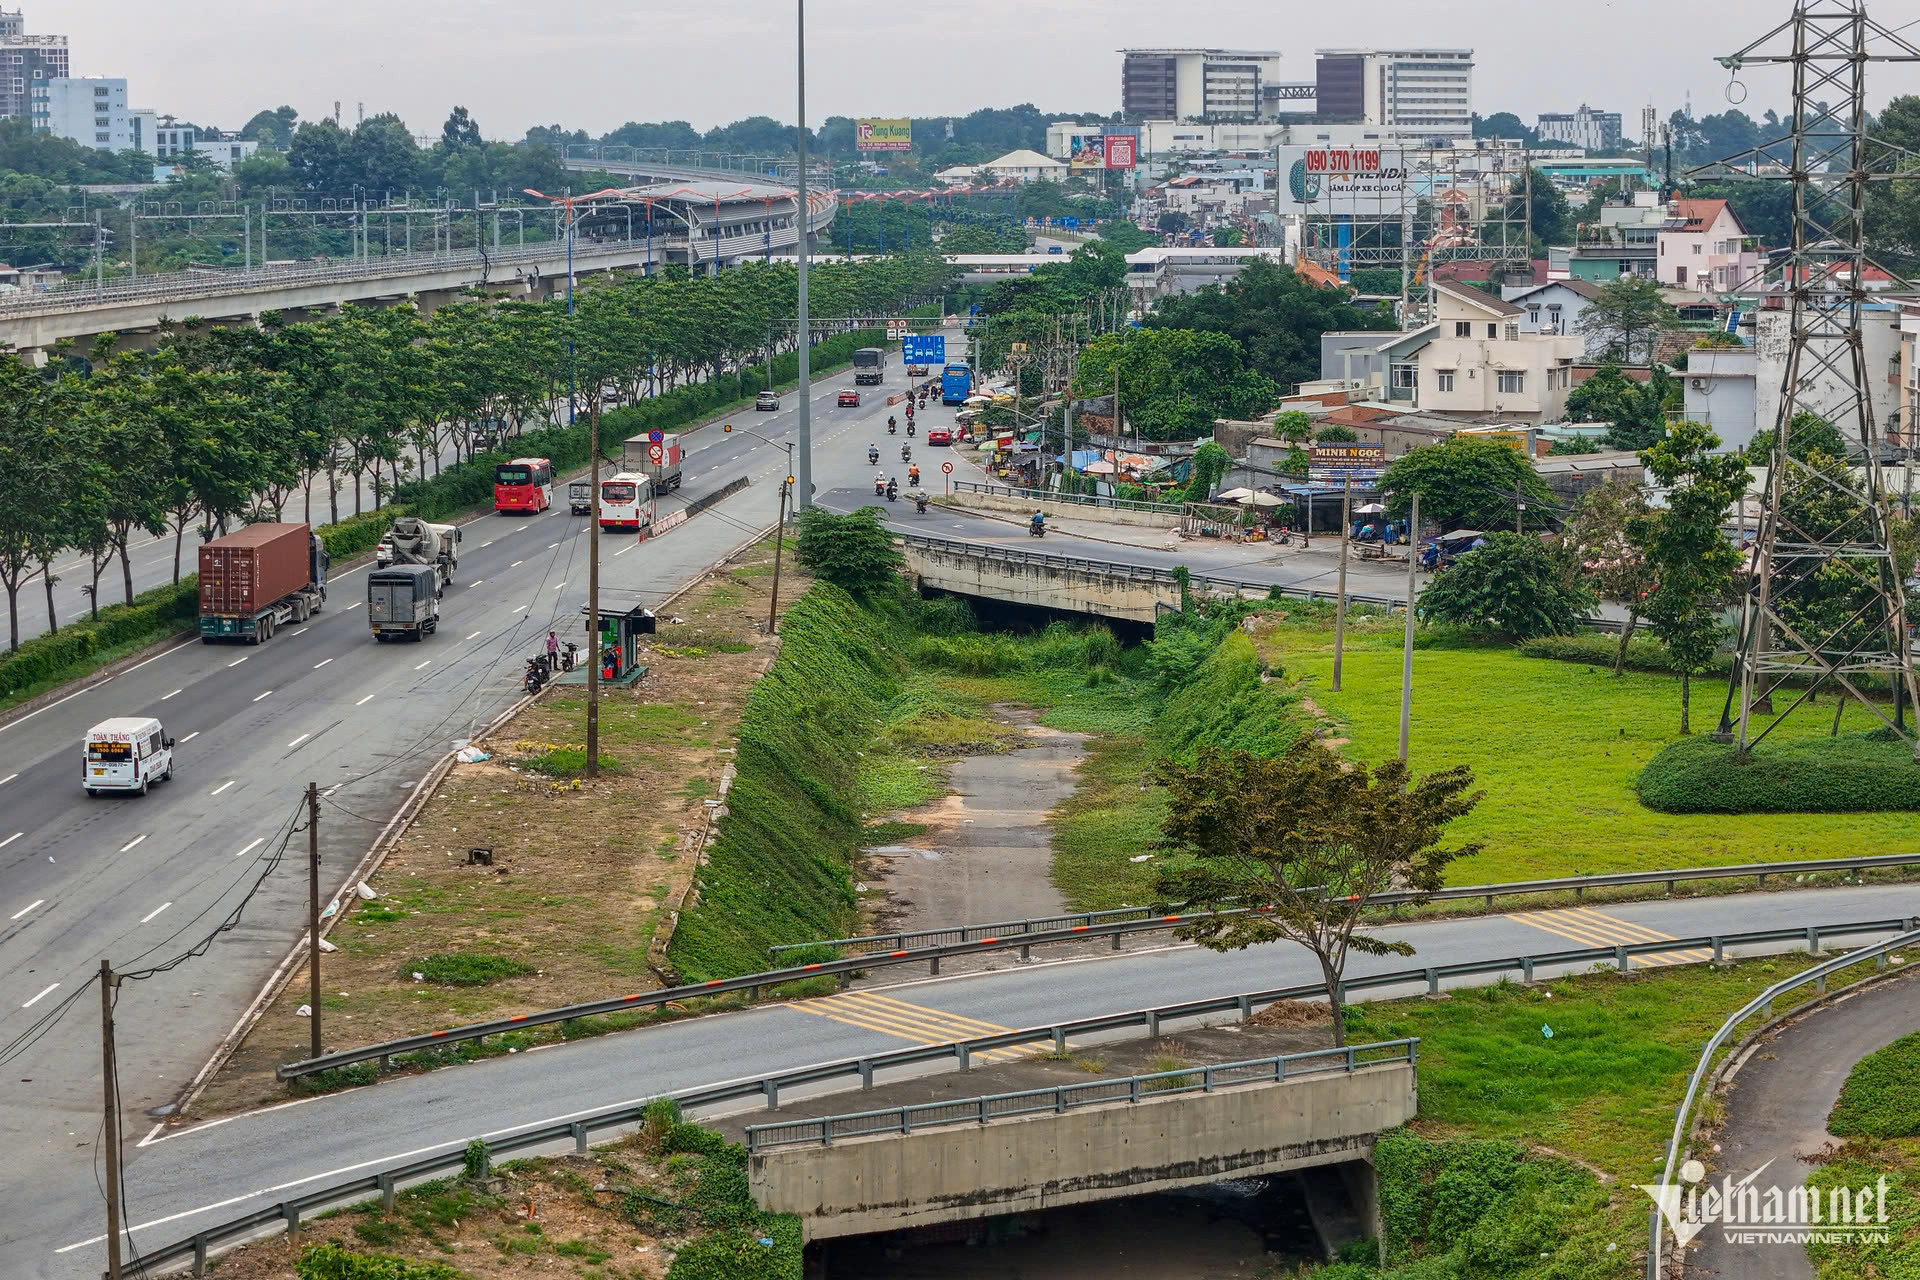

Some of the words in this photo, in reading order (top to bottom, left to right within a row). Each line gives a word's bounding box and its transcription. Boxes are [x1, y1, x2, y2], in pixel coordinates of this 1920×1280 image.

[873, 125, 888, 139] Tung
[890, 125, 910, 139] Kuang
[1307, 150, 1327, 171] 090
[1330, 150, 1349, 171] 370
[1352, 150, 1379, 171] 1199
[1316, 448, 1347, 457] MINH
